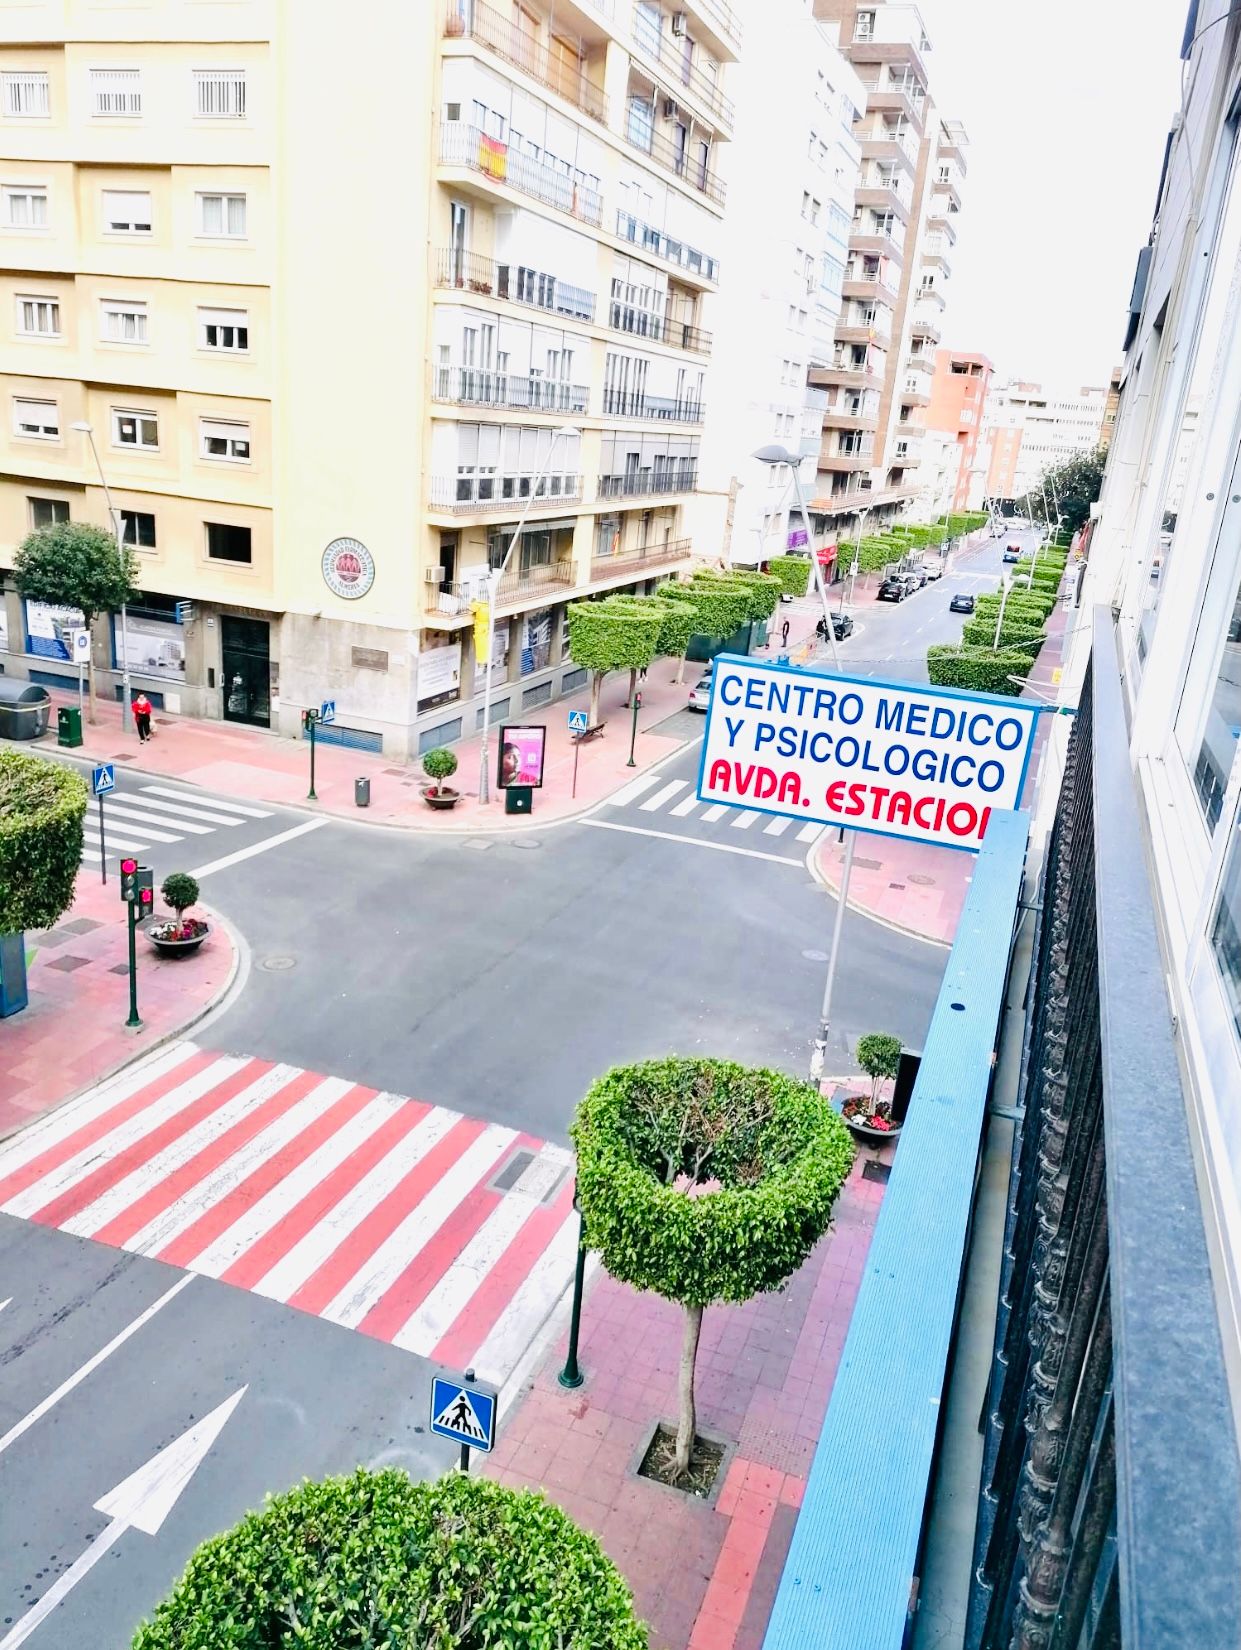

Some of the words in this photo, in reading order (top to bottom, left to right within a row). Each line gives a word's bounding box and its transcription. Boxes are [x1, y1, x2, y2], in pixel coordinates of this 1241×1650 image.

[720, 675, 864, 725] CENTRO
[875, 699, 1023, 750] MEDICO
[709, 759, 811, 807] AVDA.
[725, 717, 745, 747] Y
[755, 723, 1005, 792] PSICOLOGICO
